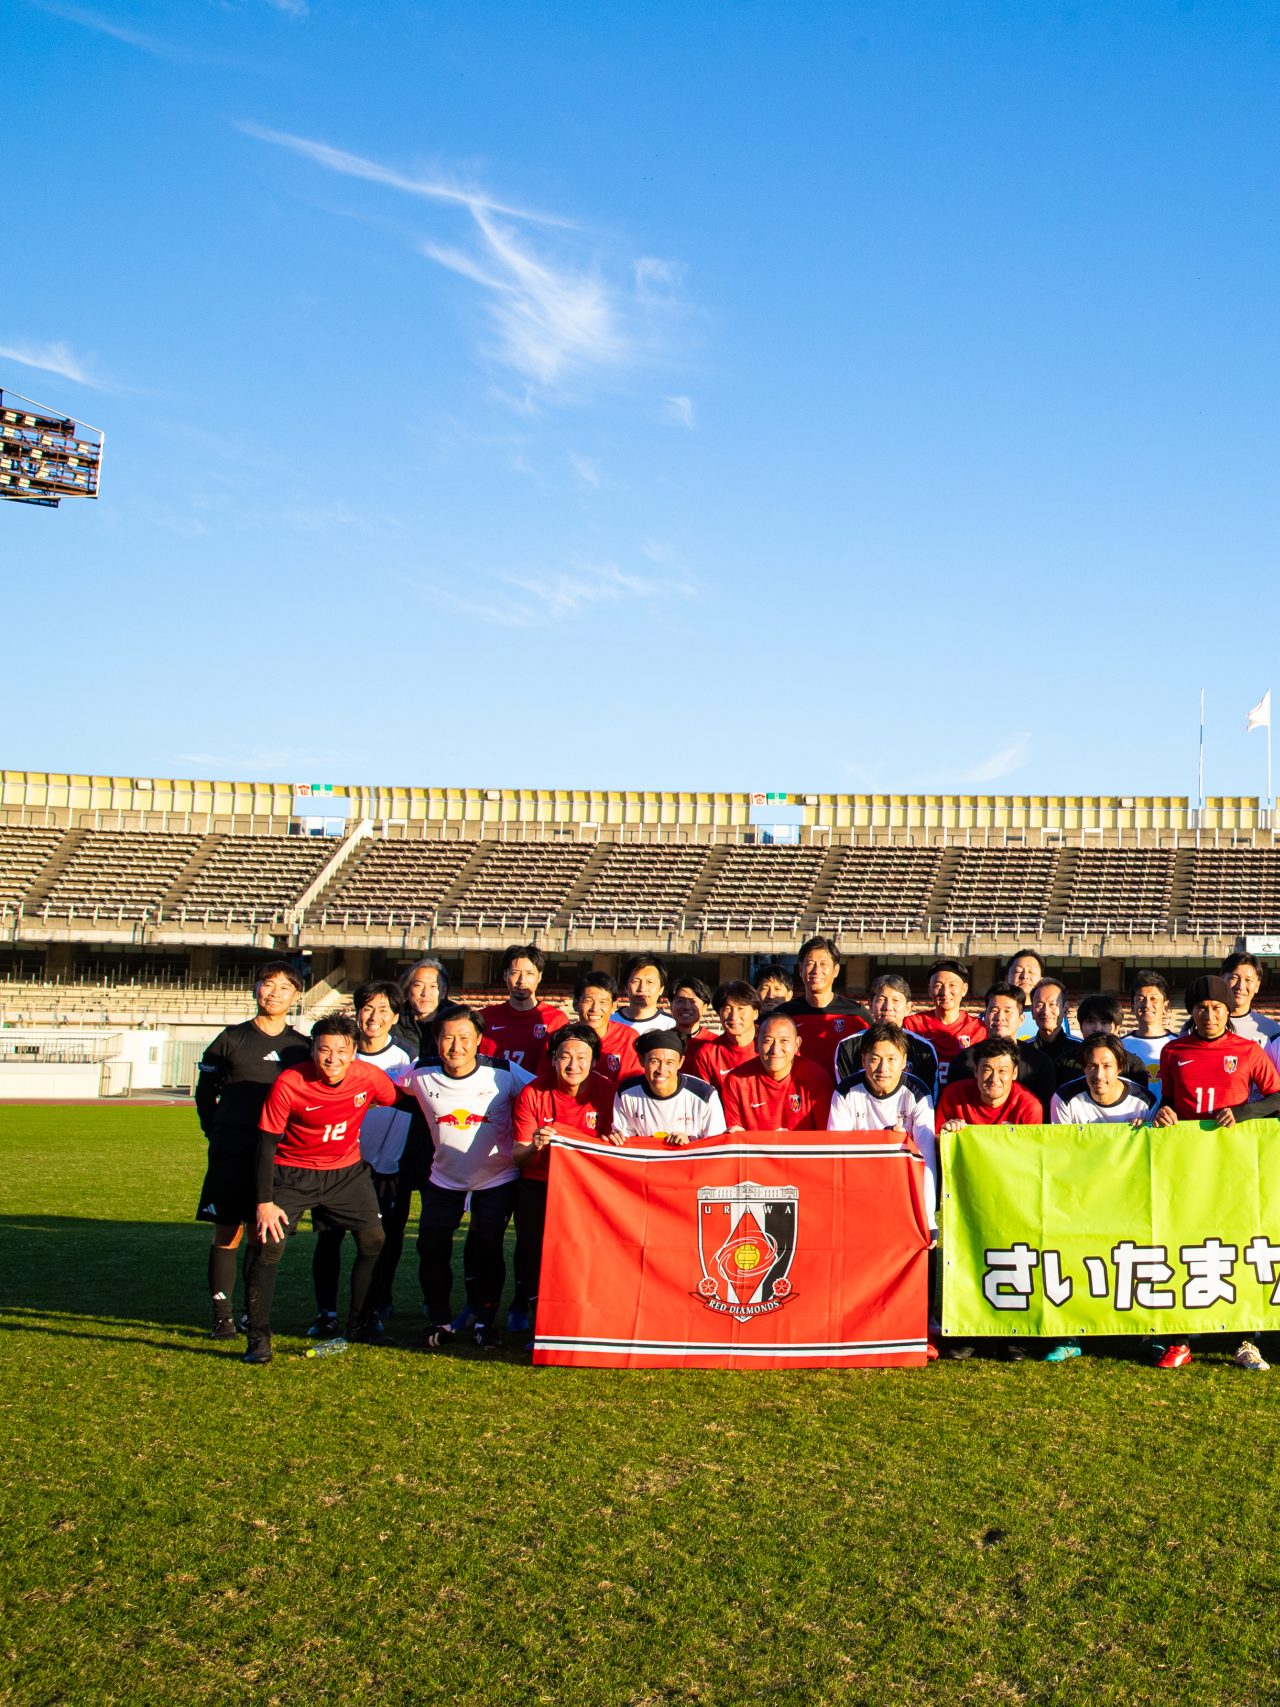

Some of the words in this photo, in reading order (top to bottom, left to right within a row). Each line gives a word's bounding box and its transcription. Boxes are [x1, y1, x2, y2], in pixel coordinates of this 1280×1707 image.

[1195, 1087, 1215, 1113] 11
[322, 1120, 347, 1143] 12
[704, 1204, 792, 1215] URAWA
[708, 1299, 727, 1312] RED
[728, 1299, 780, 1315] DIAMONDS
